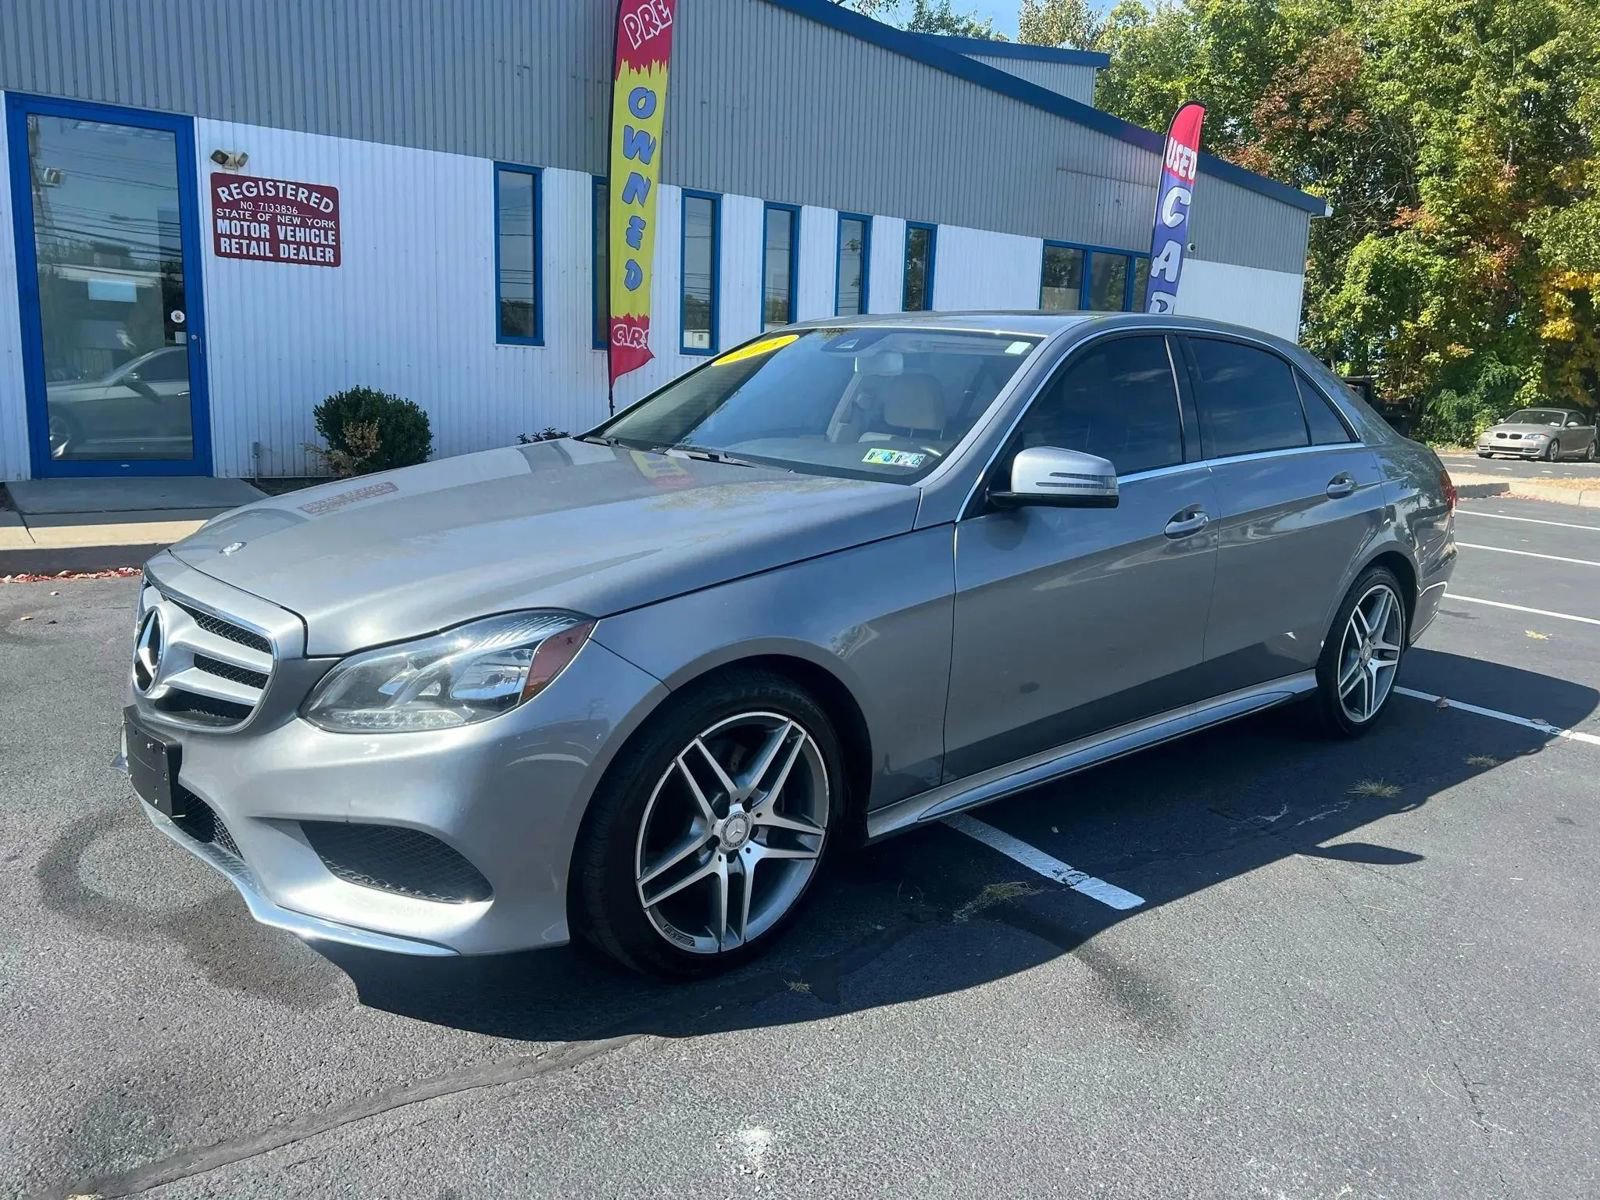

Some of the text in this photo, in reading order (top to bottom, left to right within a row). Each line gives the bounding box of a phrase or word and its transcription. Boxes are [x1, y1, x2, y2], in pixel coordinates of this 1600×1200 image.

[623, 0, 672, 50] PRE
[1166, 136, 1197, 180] USED
[216, 181, 334, 213] REGISTERED
[622, 86, 657, 291] OWNED
[216, 208, 336, 229] STATE OF NEW YORK
[240, 201, 298, 214] NO. 7133836
[216, 218, 336, 245] MOTOR VEHICLE
[220, 237, 335, 262] RETAIL DEALER
